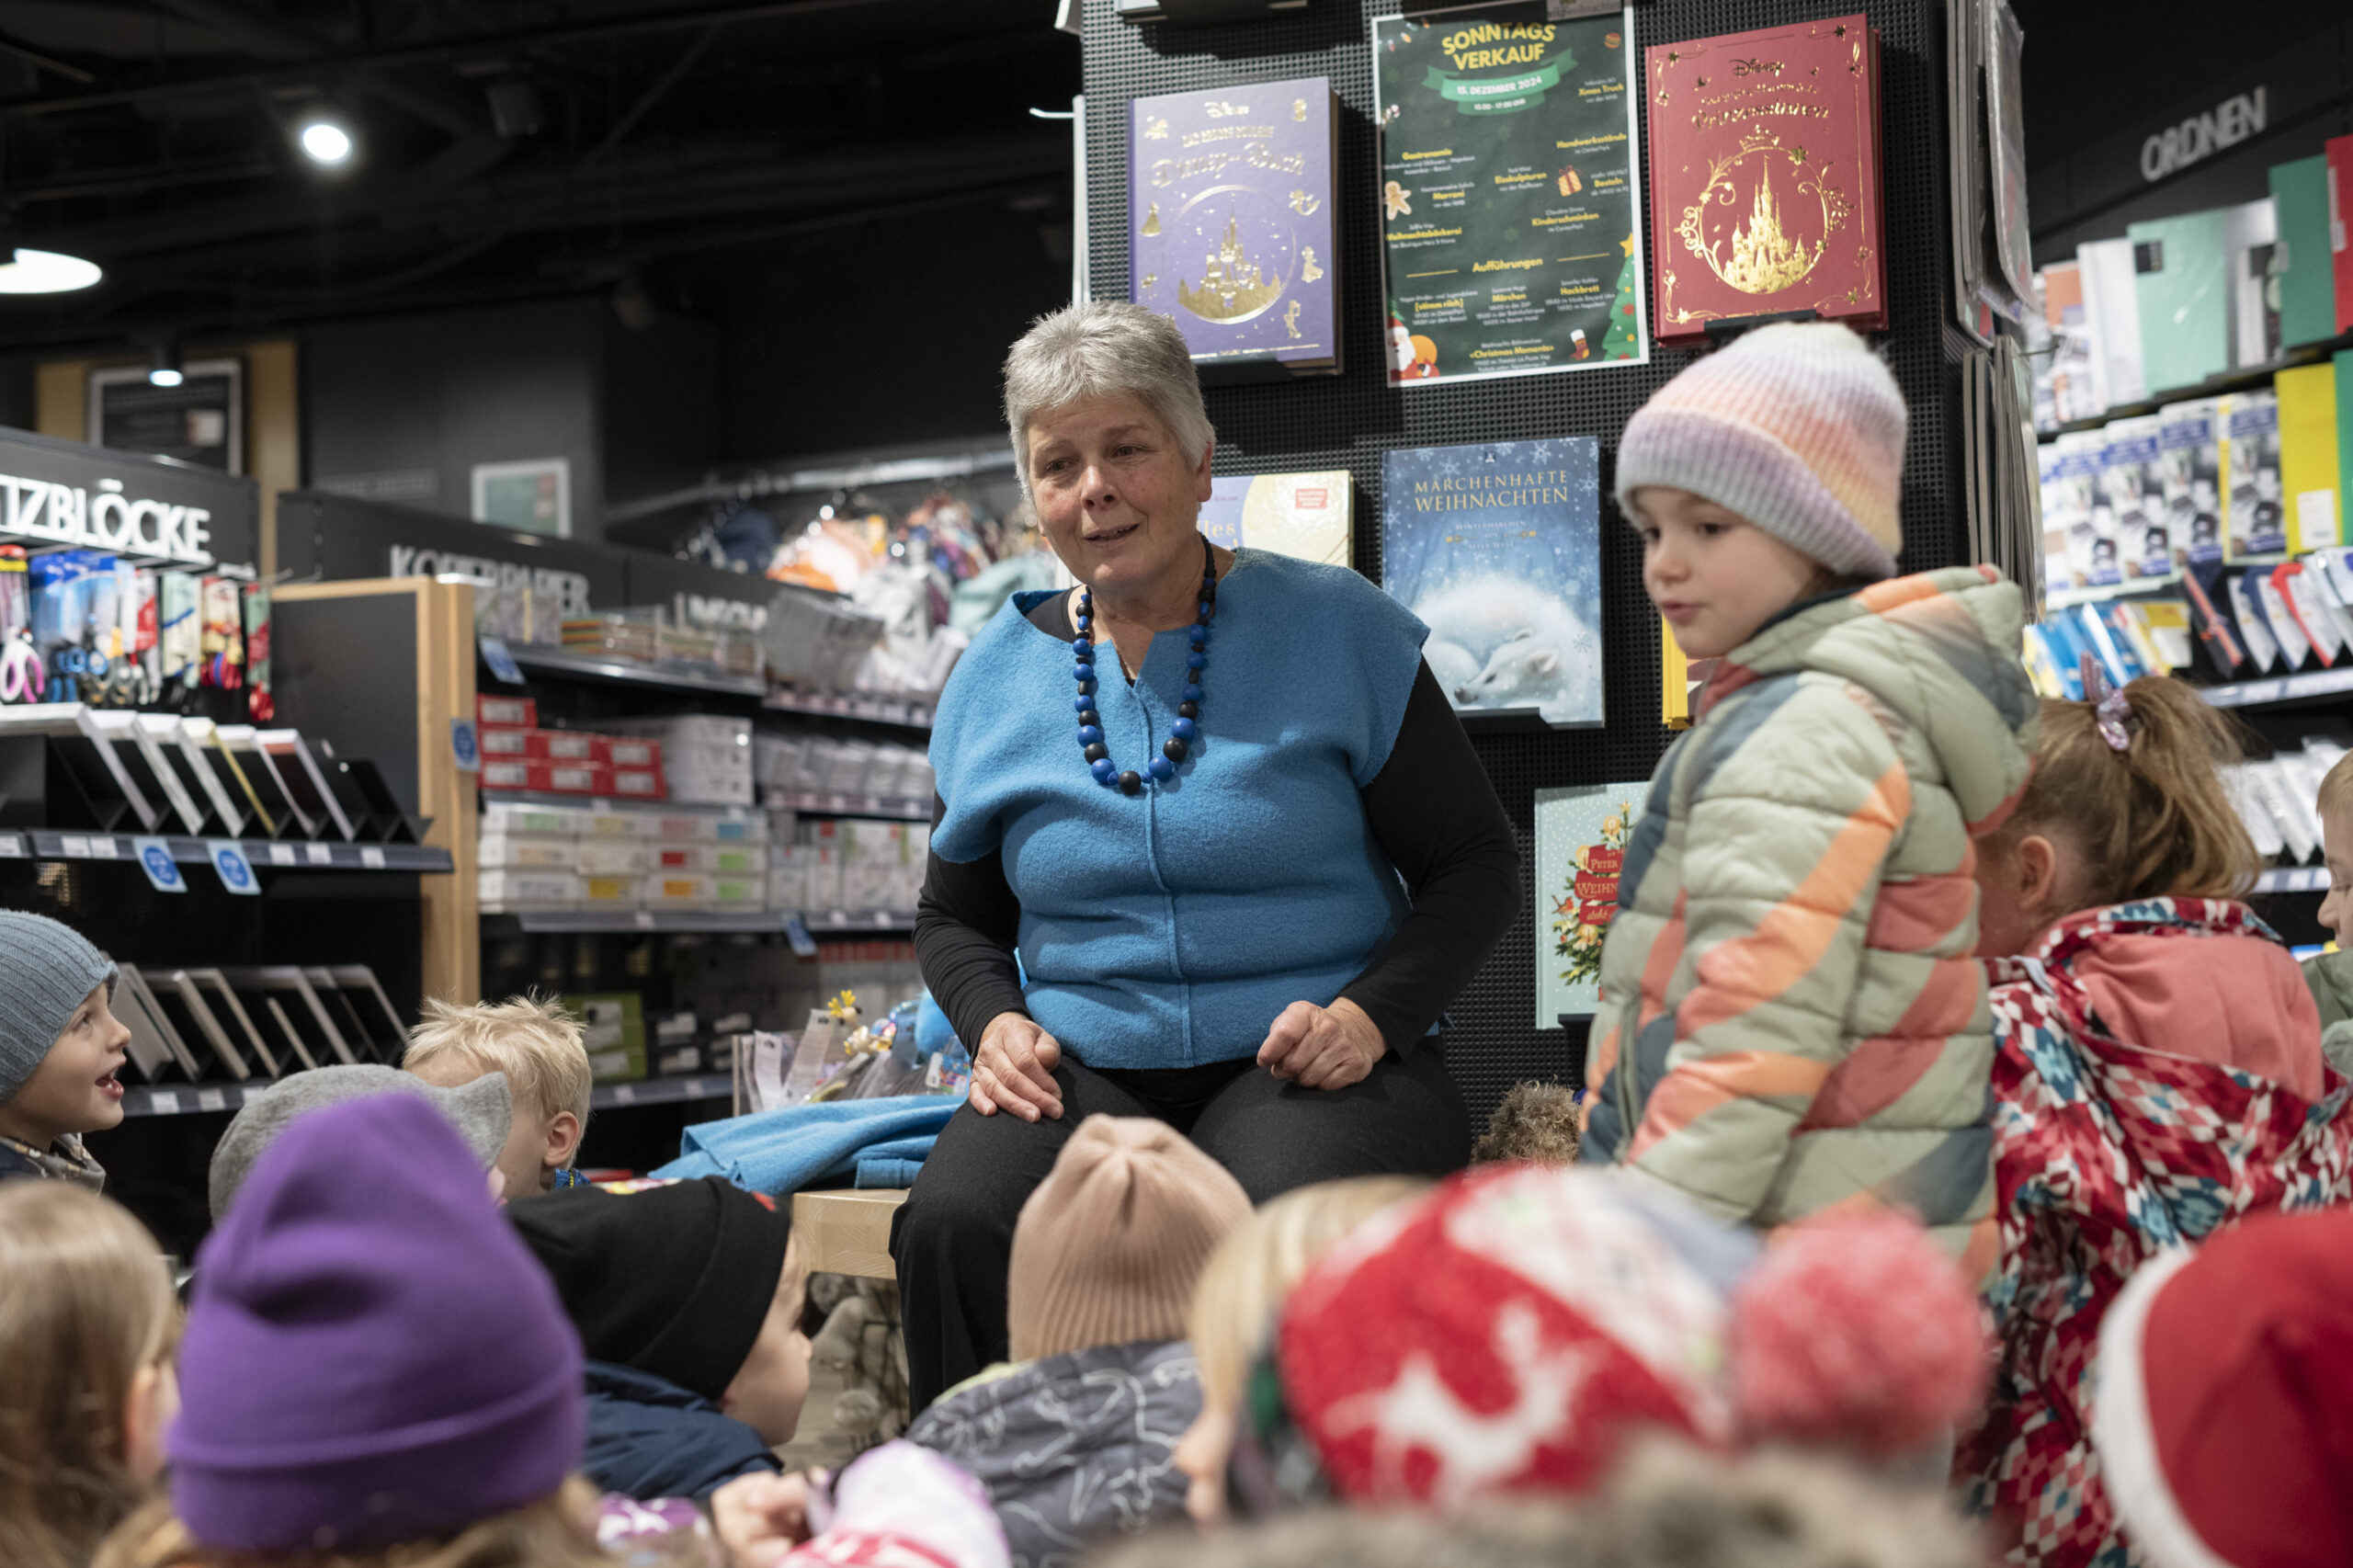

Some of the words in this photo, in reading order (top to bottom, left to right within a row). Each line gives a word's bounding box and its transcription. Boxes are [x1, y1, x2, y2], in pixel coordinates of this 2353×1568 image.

[1441, 22, 1556, 55] SONNTAGS
[1452, 42, 1545, 71] VERKAUF
[1470, 82, 1516, 96] DEZEMBER
[1518, 75, 1542, 90] 2024
[2140, 85, 2267, 181] ORDNEN
[1472, 258, 1543, 273] Aufführungen
[1492, 292, 1527, 302] Märchen
[1415, 486, 1567, 512] WEIHNACHTEN
[1591, 858, 1618, 869] PETER
